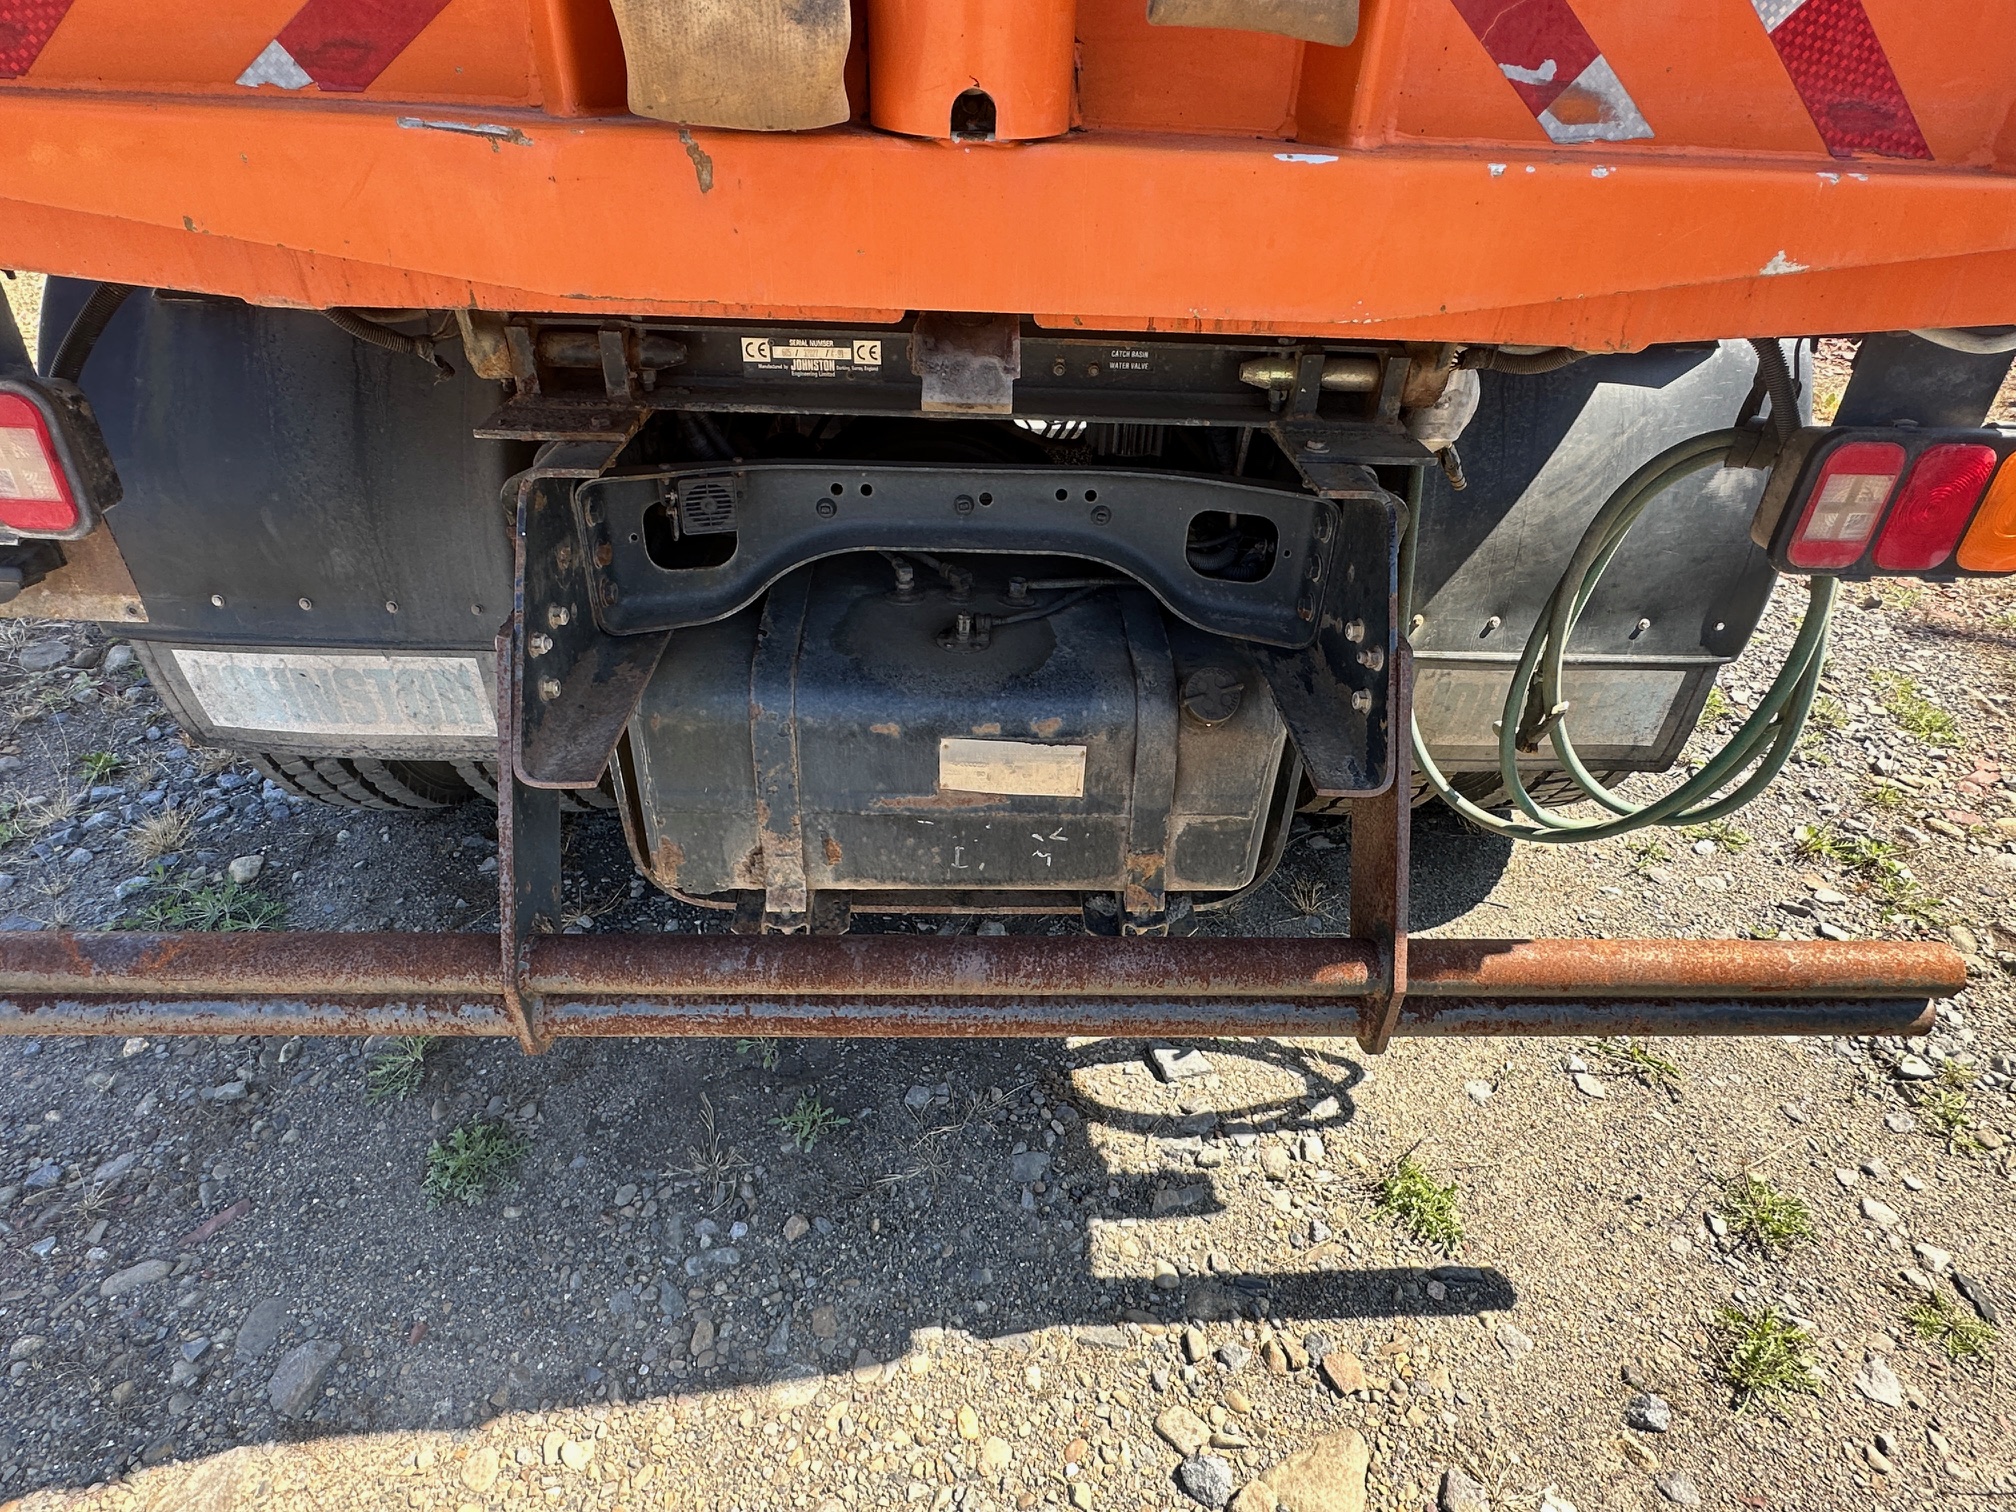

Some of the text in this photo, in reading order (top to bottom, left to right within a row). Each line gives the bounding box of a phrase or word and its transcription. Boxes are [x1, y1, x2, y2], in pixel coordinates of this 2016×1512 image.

[809, 339, 834, 347] NUMBER
[745, 342, 767, 358] CE
[856, 345, 878, 360] CE
[1111, 350, 1130, 358] CATCH
[791, 359, 835, 372] JOHNSTON
[1130, 362, 1149, 370] VALVE
[203, 664, 486, 726] OHNSTON
